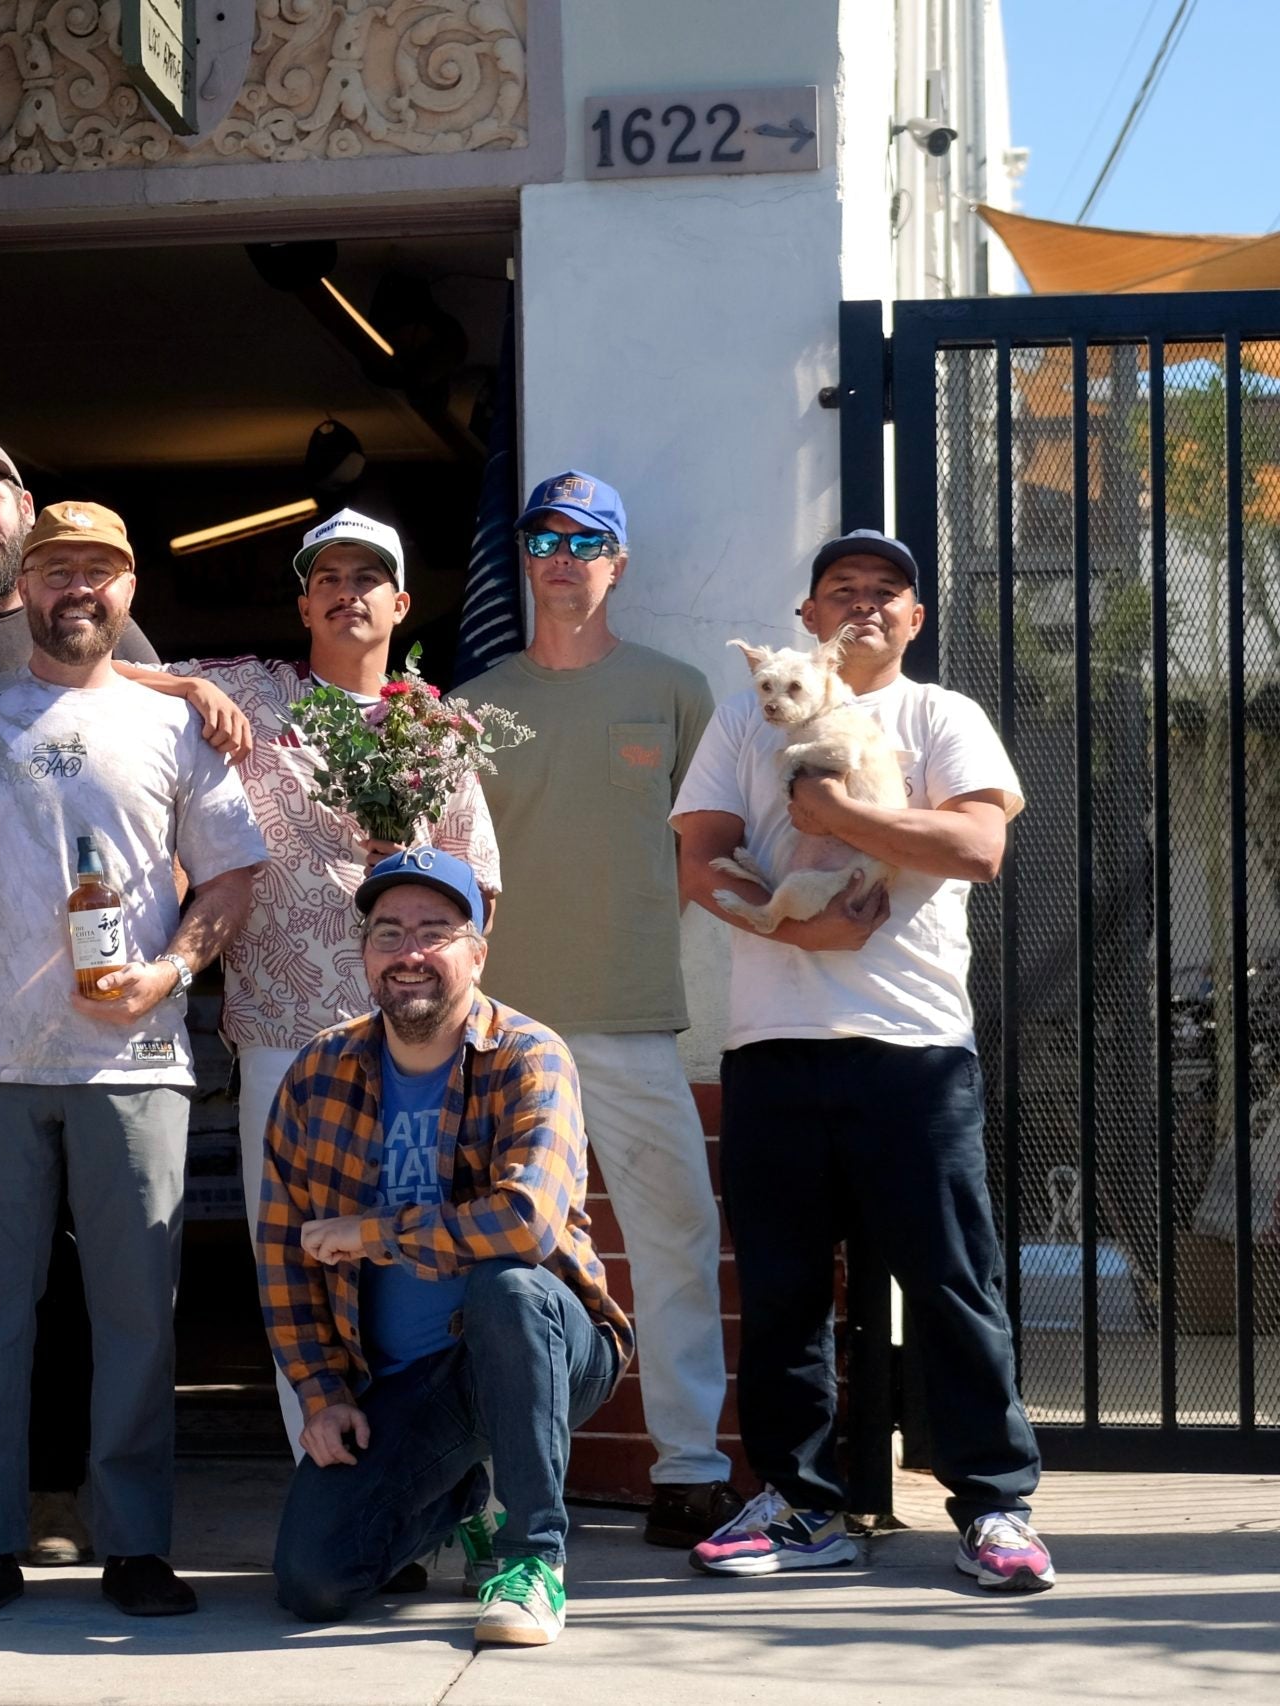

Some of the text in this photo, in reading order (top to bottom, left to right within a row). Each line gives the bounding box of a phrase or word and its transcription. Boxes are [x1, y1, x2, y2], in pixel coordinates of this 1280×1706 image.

[592, 103, 745, 167] 1622
[400, 848, 436, 870] KC
[75, 930, 95, 938] CHITA
